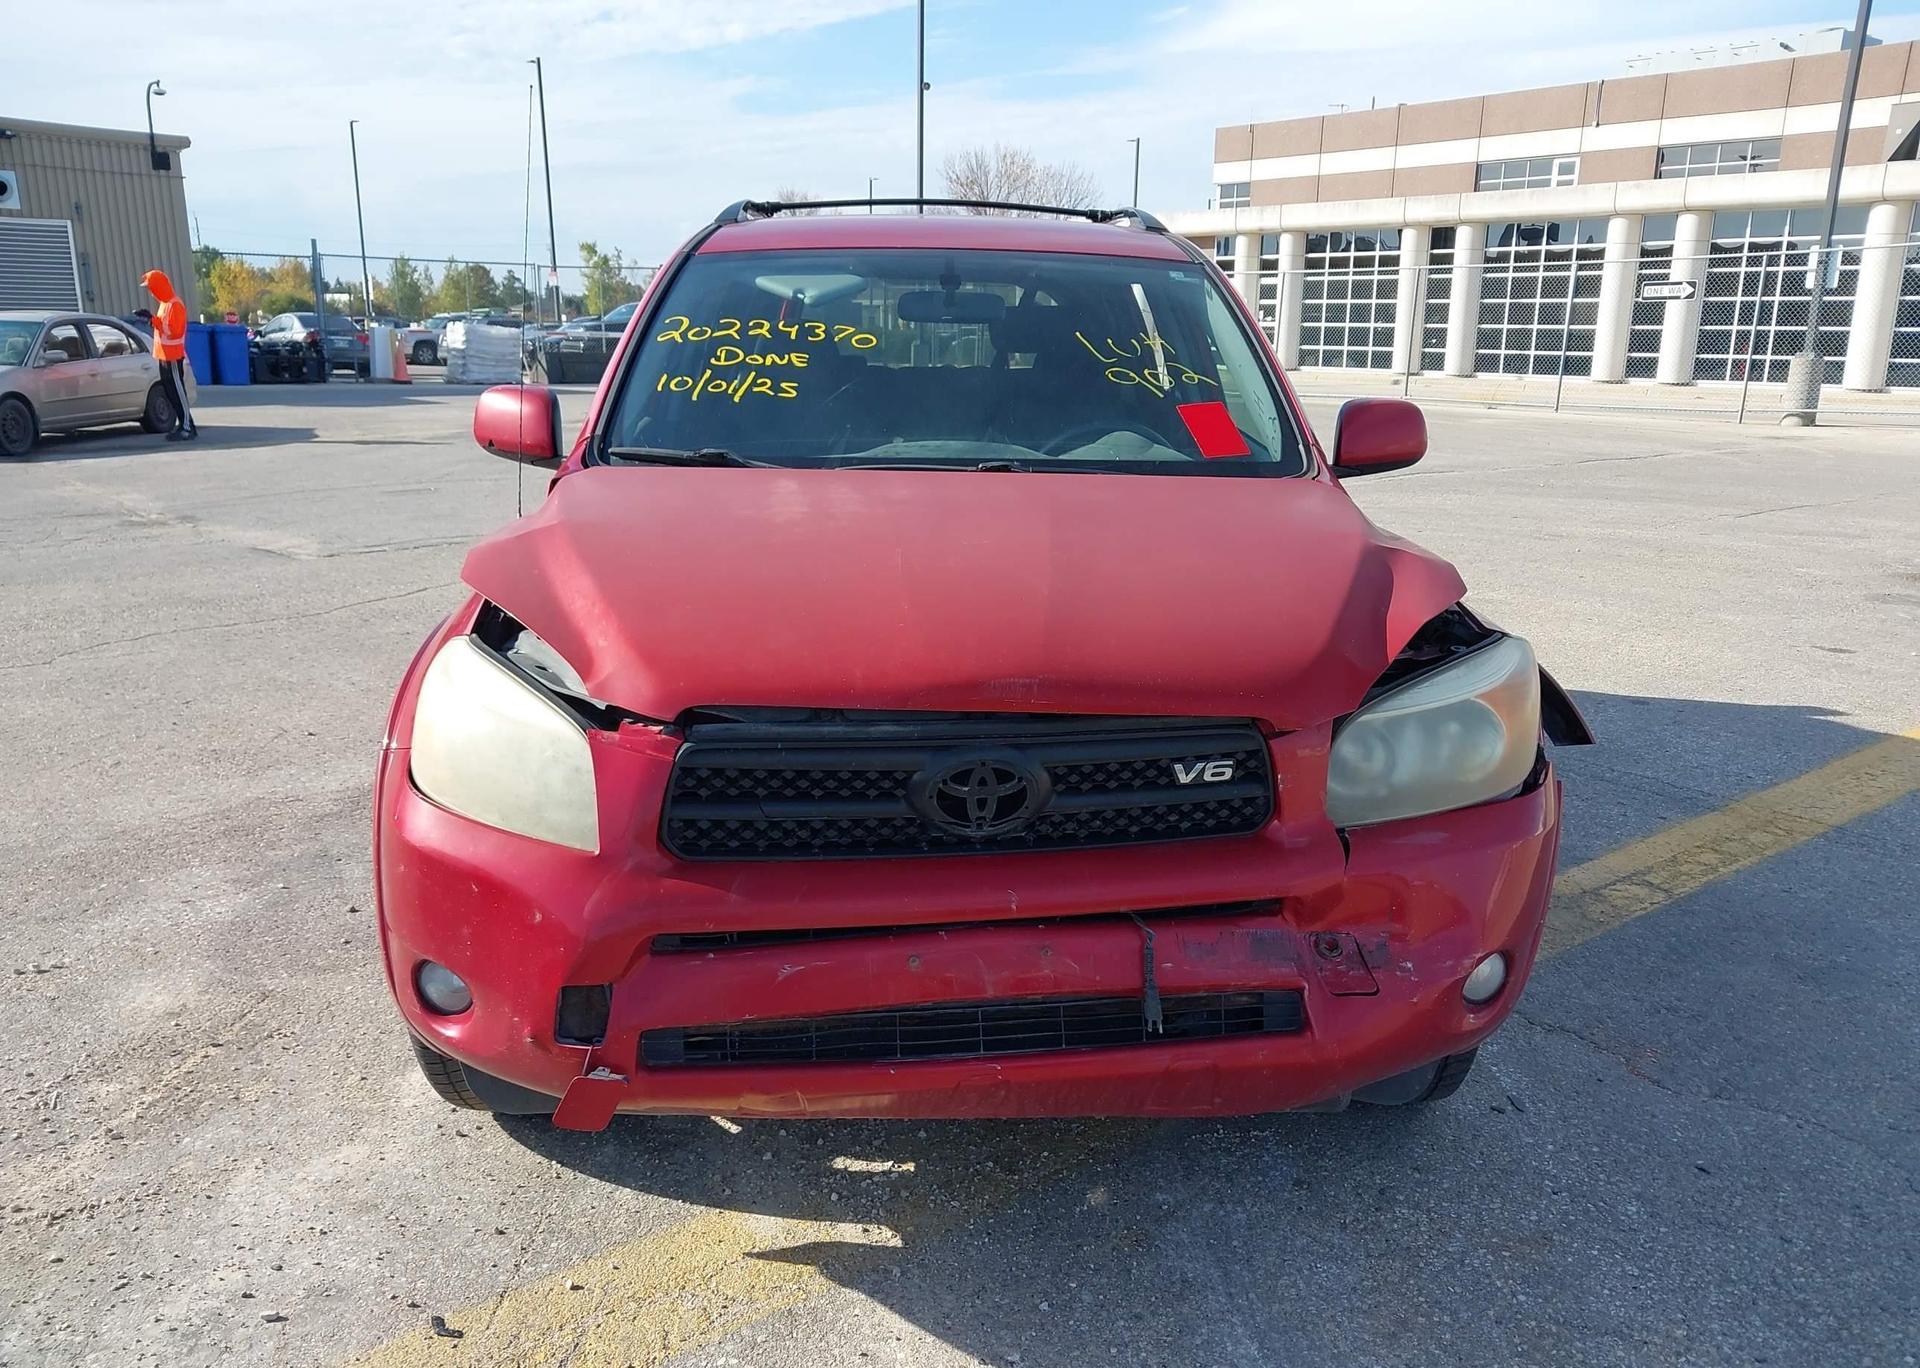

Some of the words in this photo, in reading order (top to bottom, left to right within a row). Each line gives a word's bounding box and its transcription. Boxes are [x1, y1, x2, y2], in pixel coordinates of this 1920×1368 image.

[1646, 287, 1665, 296] ONE
[1668, 286, 1688, 295] WAY
[656, 315, 878, 349] 20224370
[710, 345, 810, 368] DONE
[656, 368, 799, 402] 10/01/25
[1173, 760, 1234, 784] V6
